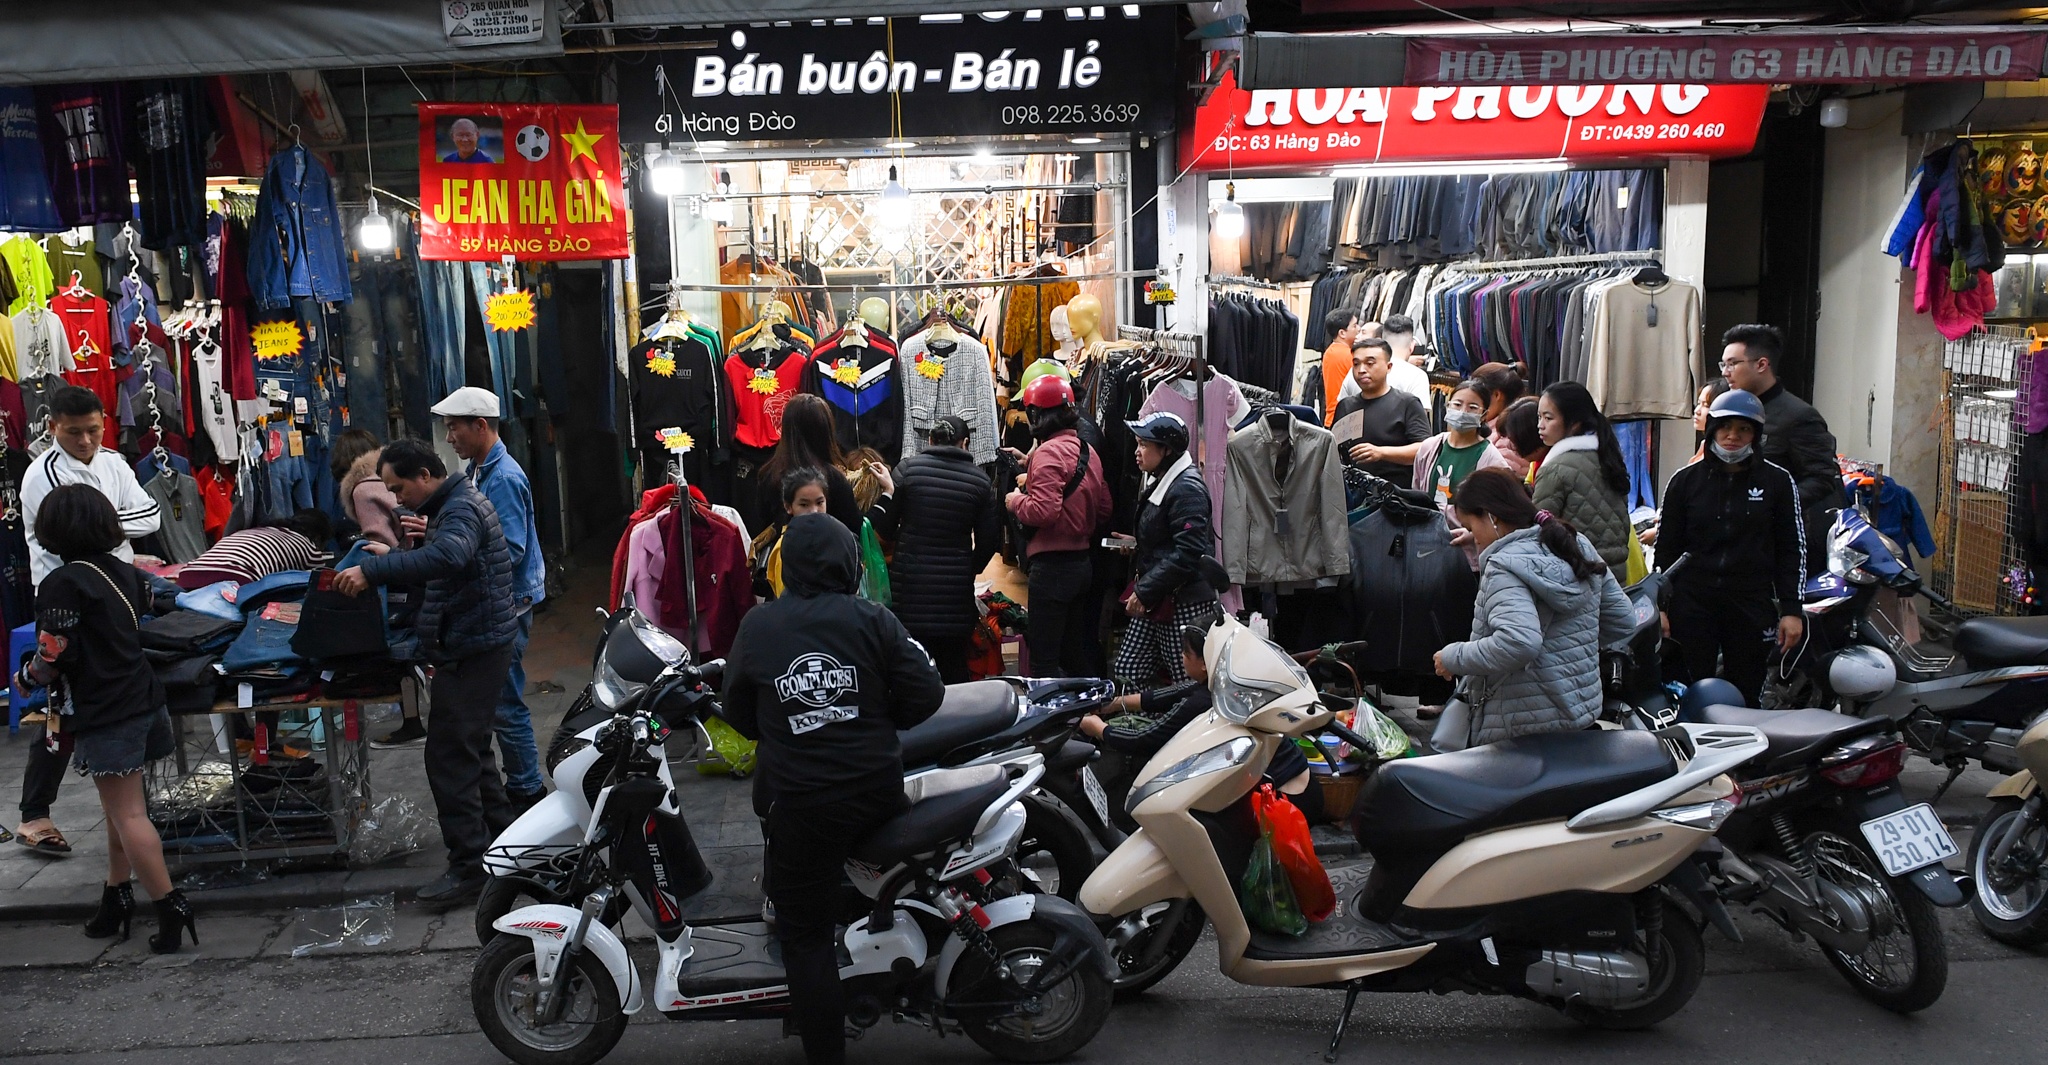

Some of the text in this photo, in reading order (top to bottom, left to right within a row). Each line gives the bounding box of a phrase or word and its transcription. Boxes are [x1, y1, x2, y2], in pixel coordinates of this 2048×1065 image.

[470, 2, 486, 12] 265
[472, 14, 528, 27] 3828.7390
[473, 25, 530, 37] 2232.8888
[692, 52, 784, 97] Bán
[797, 50, 918, 95] buôn
[948, 48, 1041, 93] Bán
[1057, 39, 1102, 89] lẻ
[1437, 38, 2012, 82] HÒA PHƯƠNG 63 HÀNG ĐÀO
[654, 110, 796, 136] 61 Hàng Đào
[1001, 103, 1141, 125] 098.225.3639
[1657, 123, 1689, 139] 260
[1692, 122, 1725, 138] 460
[1250, 134, 1270, 150] 63
[1274, 132, 1319, 153] Hàng
[433, 169, 614, 235] JEAN HẠ GIÁ
[460, 234, 591, 253] 59 HÀNG ĐÀO
[258, 338, 289, 350] JEANS
[780, 669, 853, 698] COMPLICES
[1882, 832, 1952, 872] 250.14
[647, 843, 668, 888] HT-BIKE
